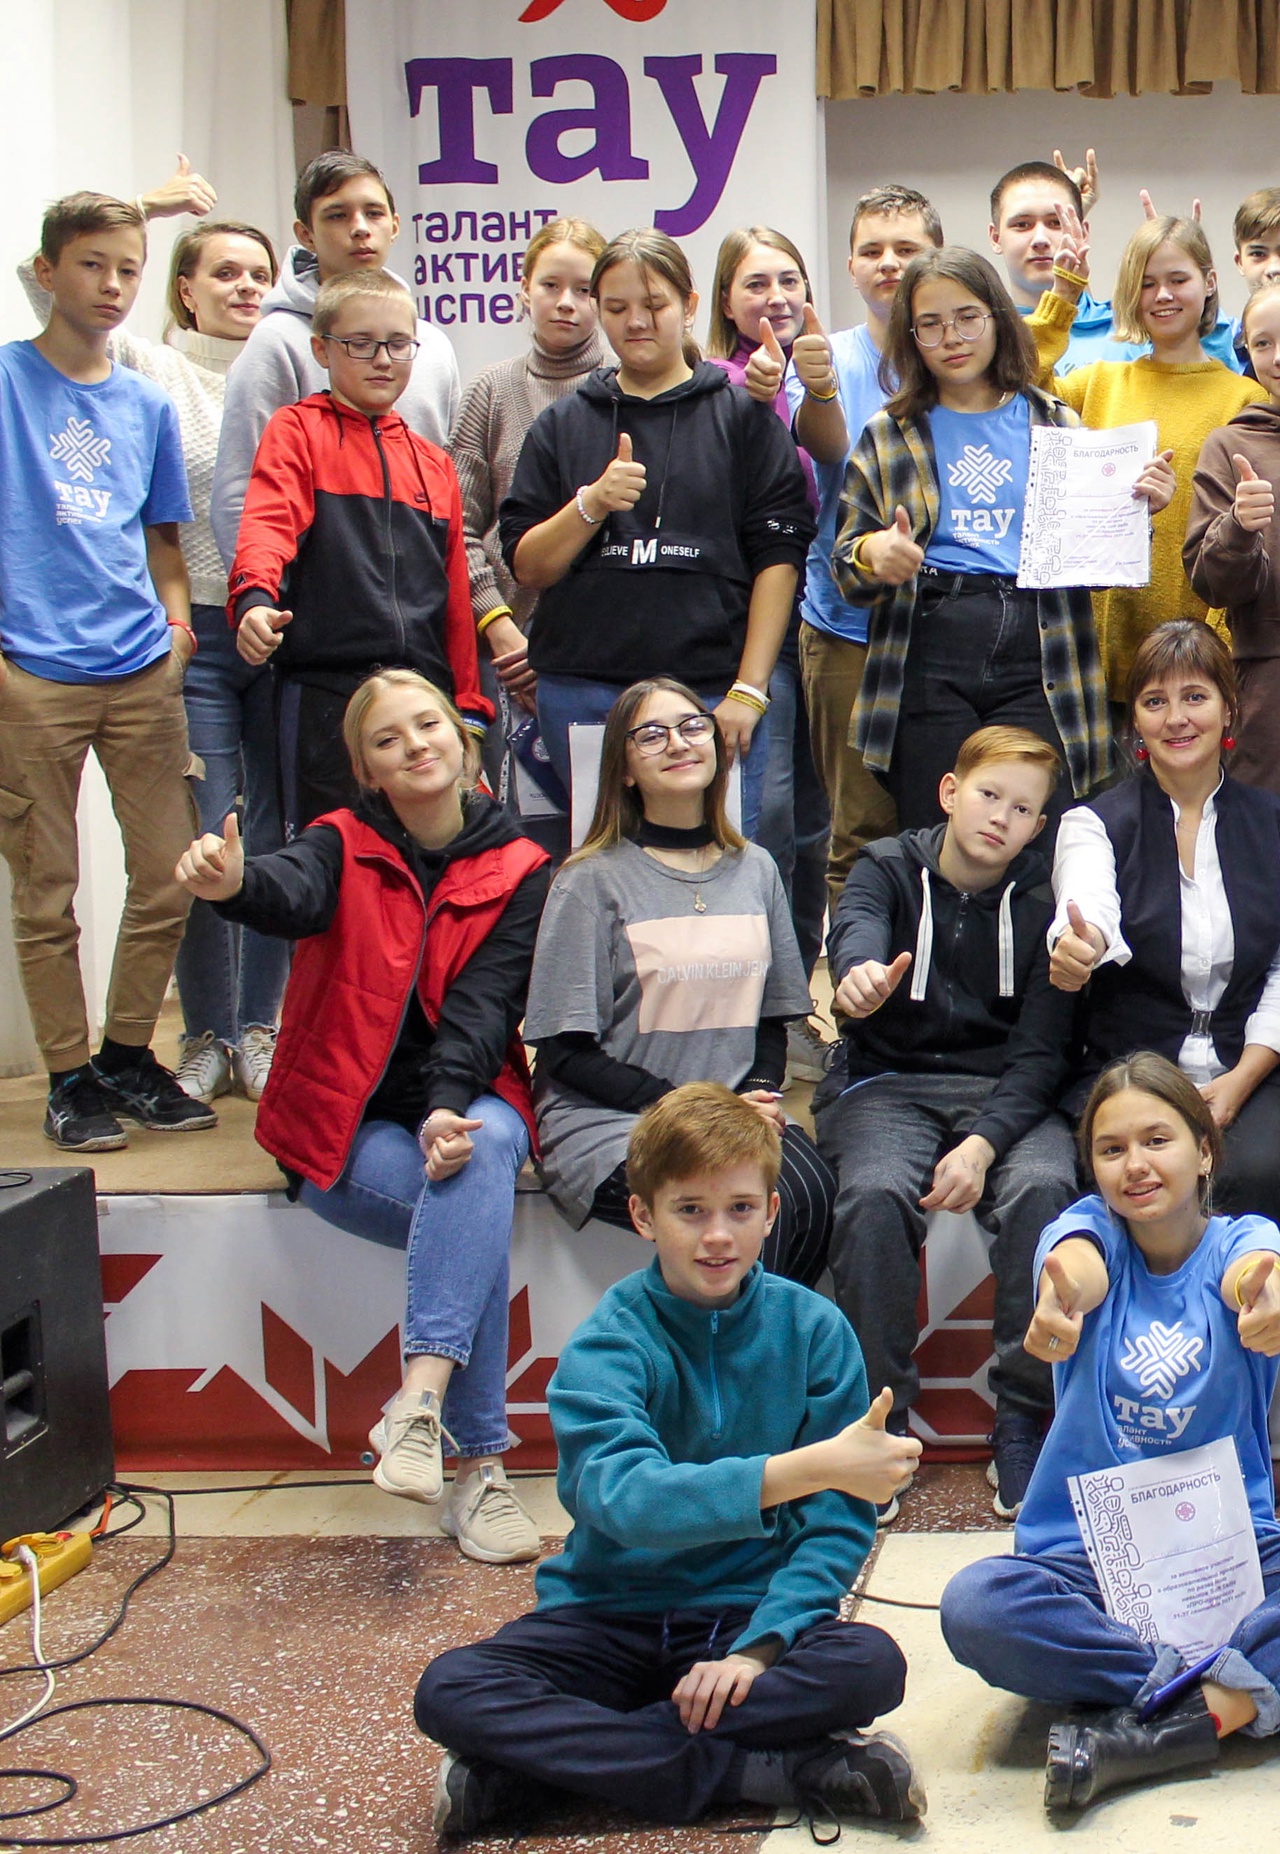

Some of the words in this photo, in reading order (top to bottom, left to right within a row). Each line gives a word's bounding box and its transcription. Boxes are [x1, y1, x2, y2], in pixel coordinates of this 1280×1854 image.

[405, 53, 777, 237] тау
[1073, 444, 1139, 458] БЛАГОДАРНОСТЬ
[54, 480, 112, 518] тау
[951, 508, 1016, 538] тау
[631, 538, 658, 565] M
[661, 545, 700, 559] ONESELF
[657, 963, 704, 984] CALVIN
[706, 960, 742, 979] KLEIN
[1113, 1395, 1197, 1439] тау
[1130, 1472, 1221, 1504] БЛАГОДАРНОСТЬ
